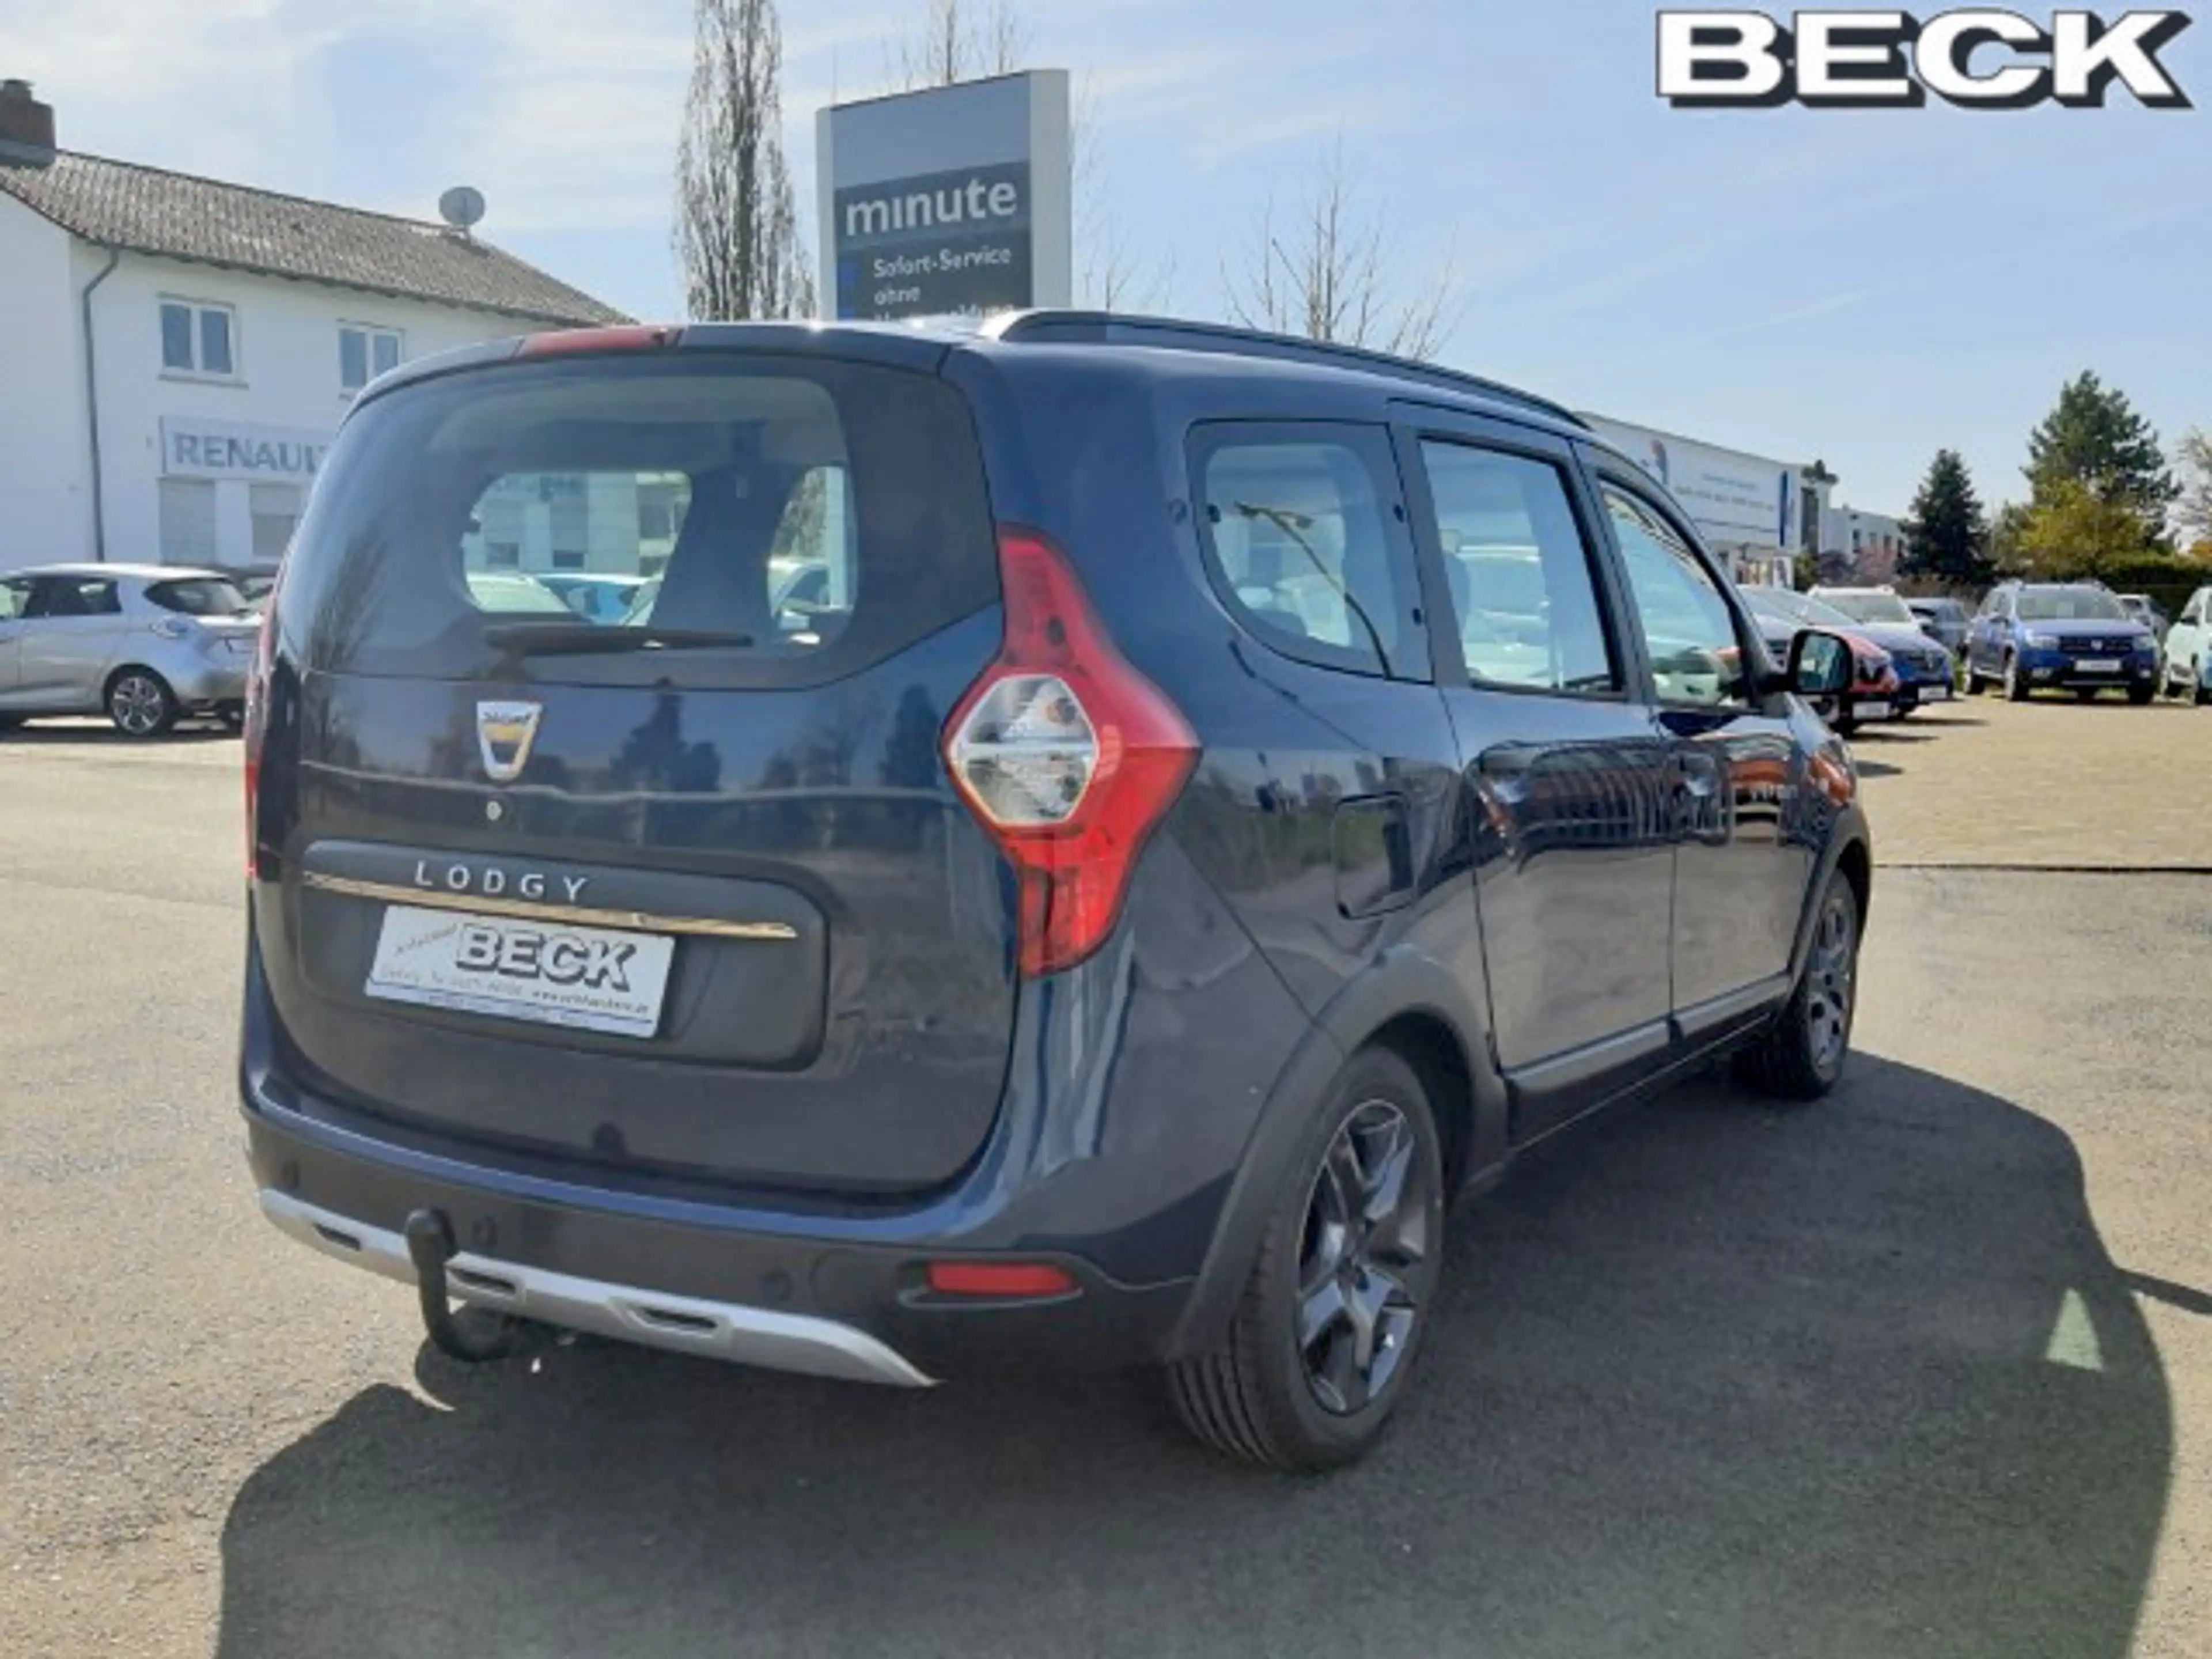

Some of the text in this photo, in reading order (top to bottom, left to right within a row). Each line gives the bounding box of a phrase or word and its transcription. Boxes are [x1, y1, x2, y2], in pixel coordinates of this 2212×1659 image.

[846, 179, 1017, 237] minute
[415, 860, 586, 901] LODGY
[455, 922, 637, 992] BECK
